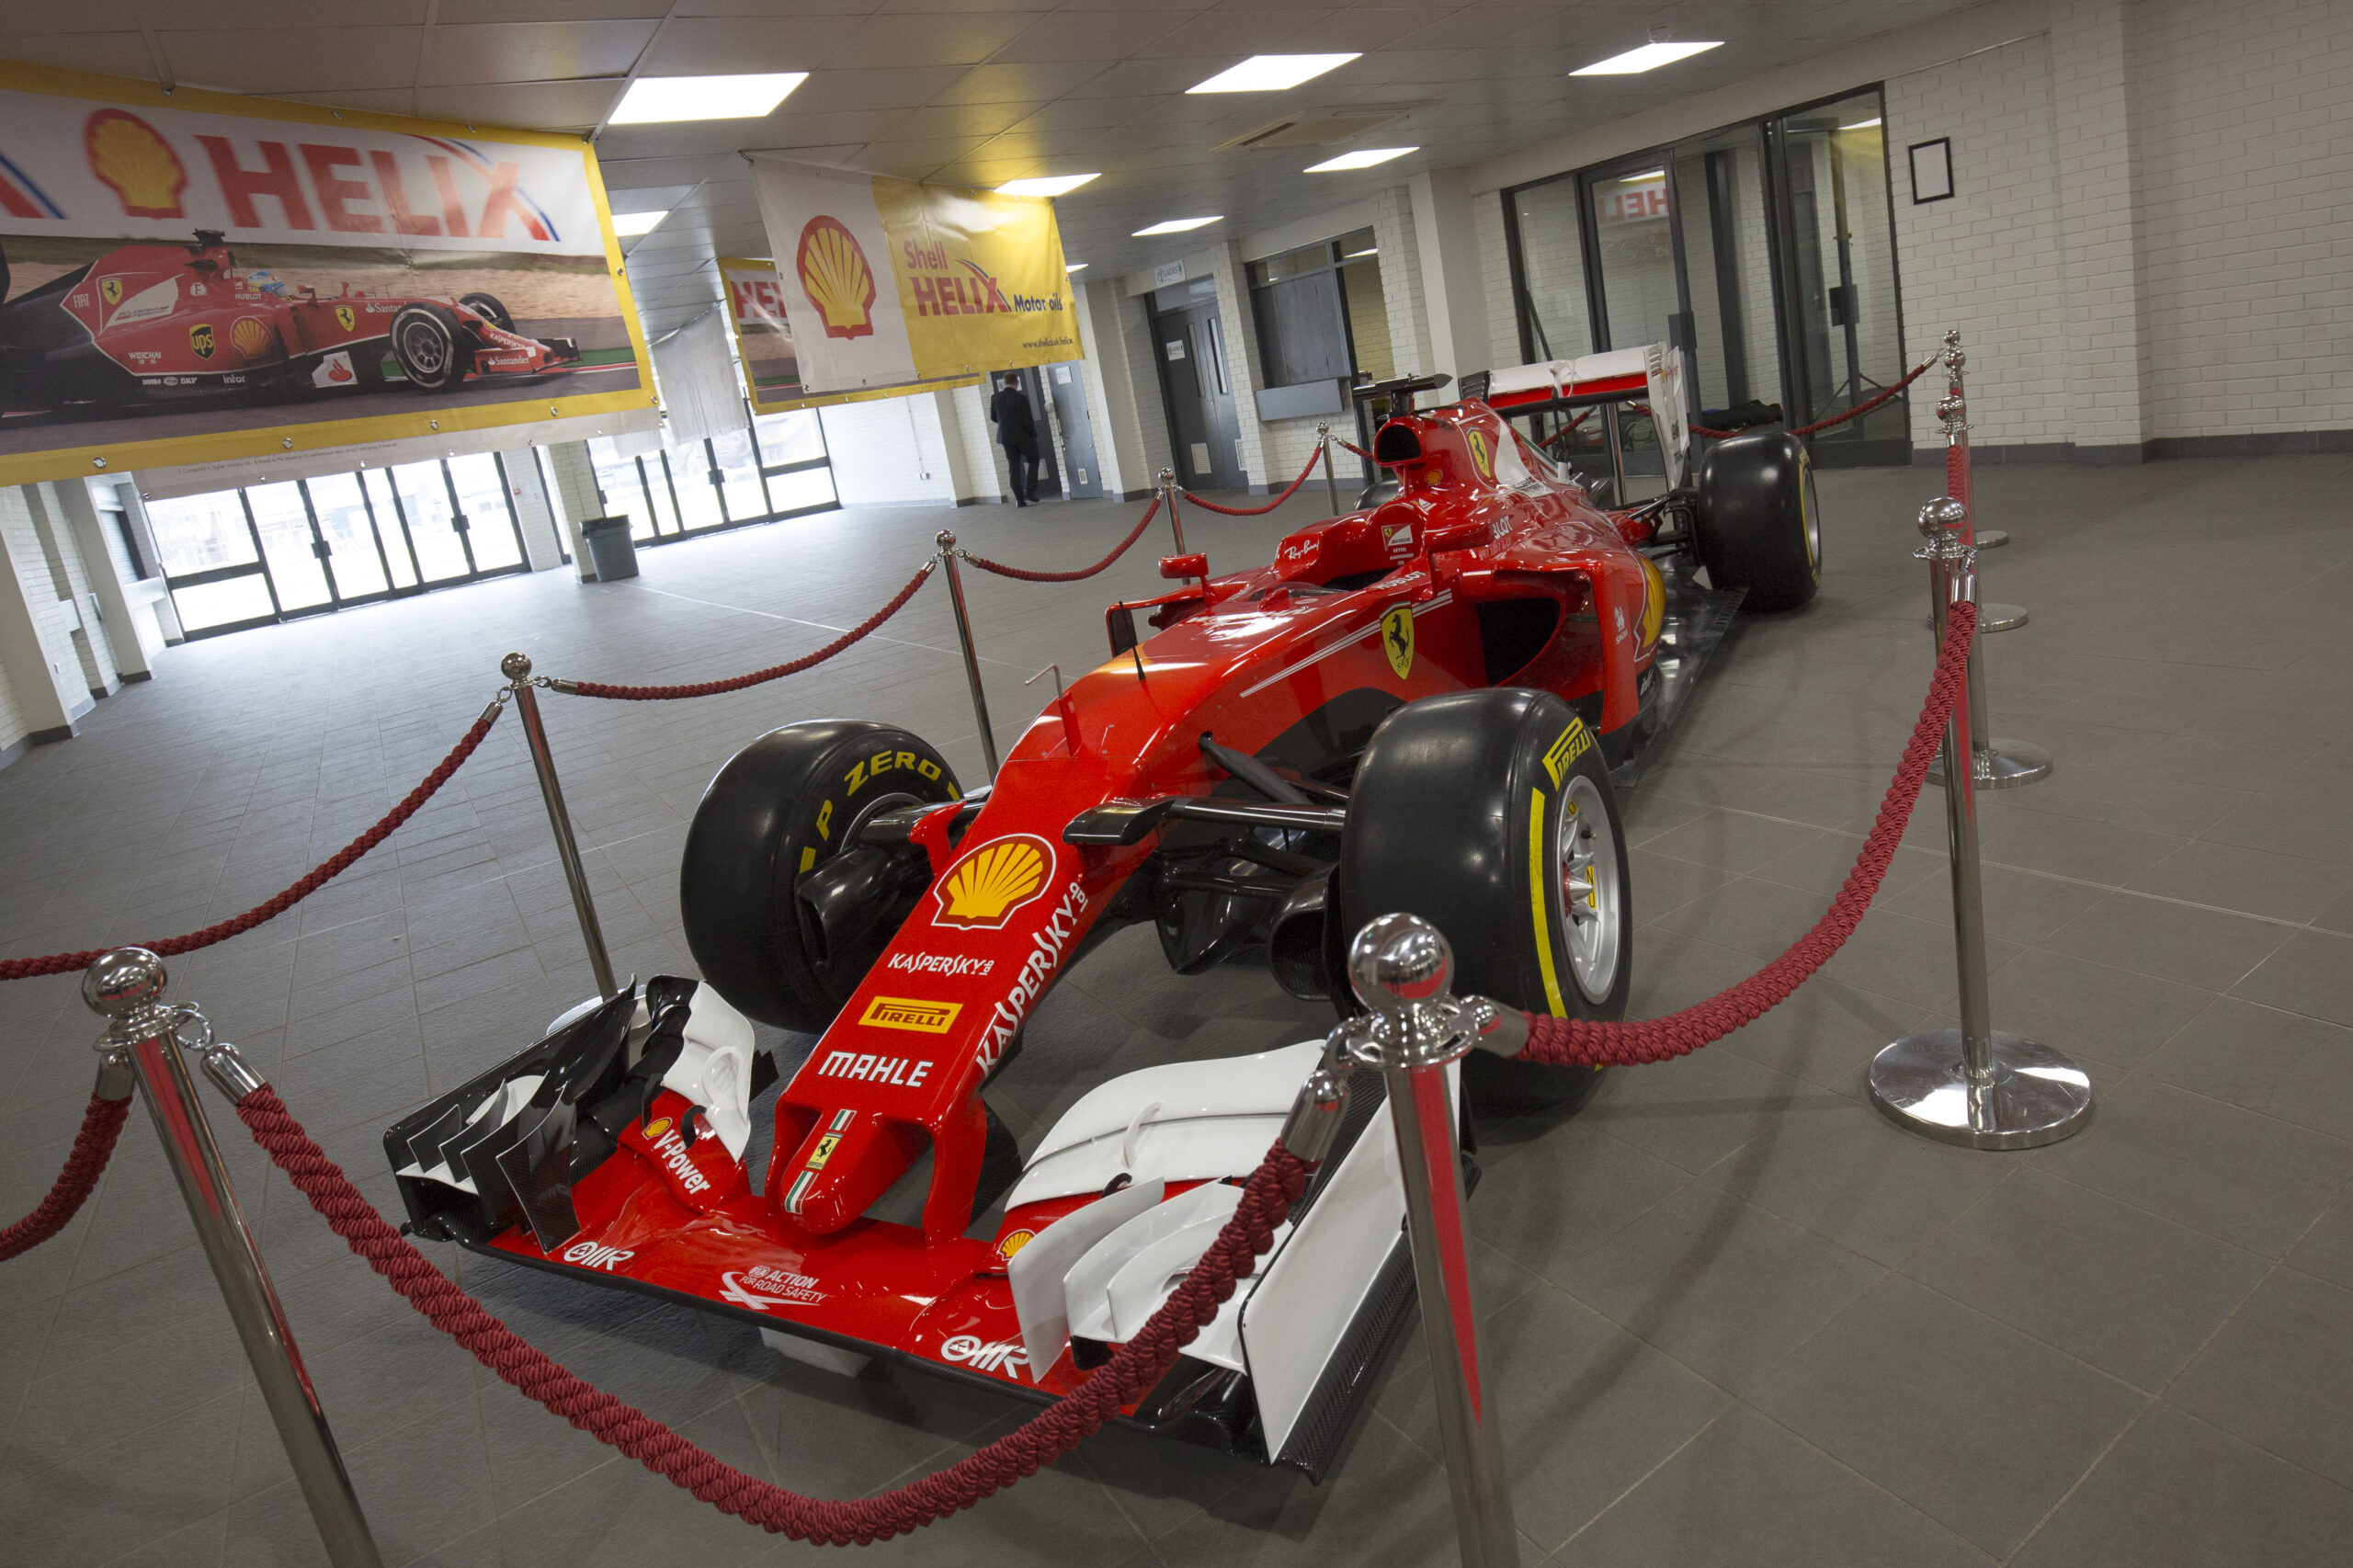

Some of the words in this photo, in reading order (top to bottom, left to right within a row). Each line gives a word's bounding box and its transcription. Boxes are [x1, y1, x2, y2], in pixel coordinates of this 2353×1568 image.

[192, 133, 555, 241] HELIX
[904, 240, 949, 270] Shell
[73, 293, 90, 310] FIAT
[909, 266, 1010, 316] HELIX
[1013, 294, 1046, 312] Motor
[1049, 292, 1063, 312] oils
[192, 334, 213, 355] ups
[494, 355, 529, 366] Santander
[222, 375, 246, 384] infor
[1285, 539, 1320, 560] Ray-Ban
[1541, 716, 1591, 792] PIRELLI
[844, 749, 942, 797] ZERO
[887, 951, 986, 977] KASPERSKY
[978, 960, 995, 976] lab
[975, 893, 1077, 1078] KASPERSKY
[1069, 881, 1089, 913] lab
[870, 1003, 950, 1027] PIRELLI
[817, 1051, 934, 1087] MAHLE
[653, 1129, 710, 1195] V-Power
[739, 1276, 757, 1285] FOR
[753, 1279, 785, 1294] ROAD
[781, 1286, 828, 1302] SAFETY
[765, 1269, 820, 1289] ACTION
